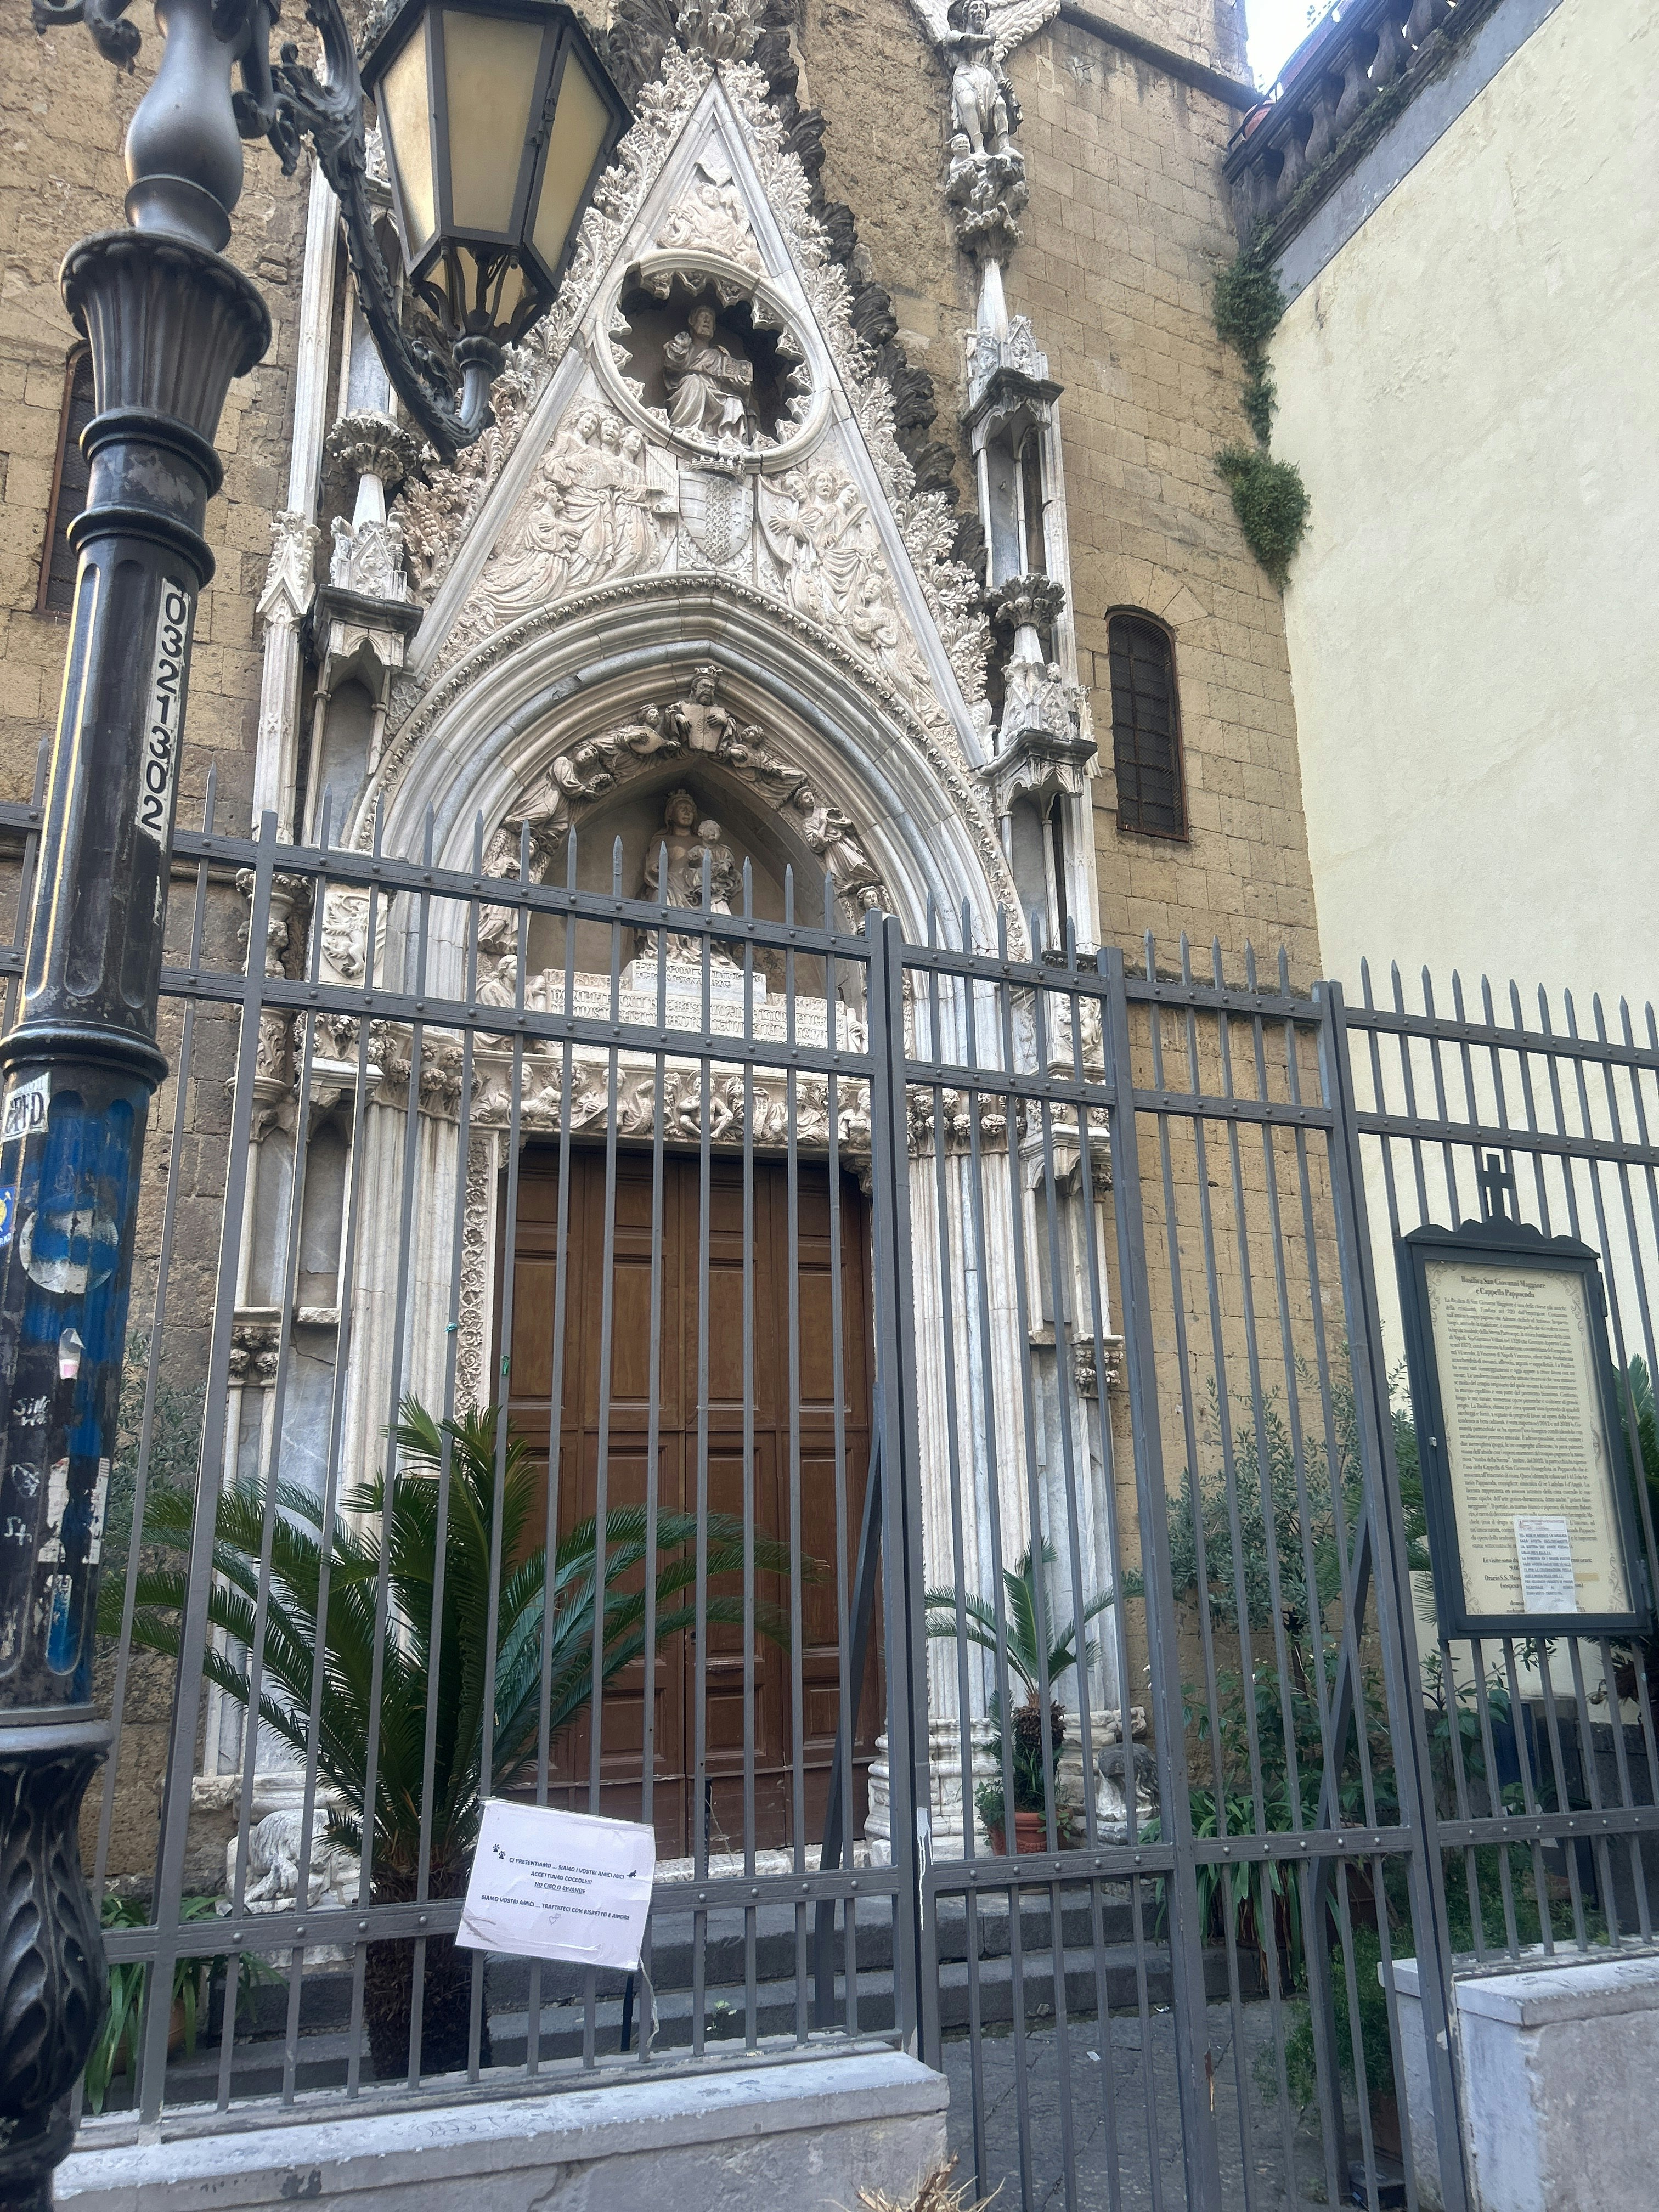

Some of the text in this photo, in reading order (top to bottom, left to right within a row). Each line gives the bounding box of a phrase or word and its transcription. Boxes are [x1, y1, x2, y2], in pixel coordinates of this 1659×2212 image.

[142, 592, 187, 831] 0321302
[1461, 1276, 1483, 1284] Basilica
[1494, 1278, 1520, 1286] Giovanni
[1480, 1287, 1505, 1297] Cappella
[516, 1858, 551, 1868] PRESENTIAMO
[531, 1871, 564, 1880] ACCETTIAMO
[562, 1886, 585, 1894] BEVANDE
[541, 1903, 571, 1912] TRATTATECI
[584, 1909, 607, 1917] RISPETTO
